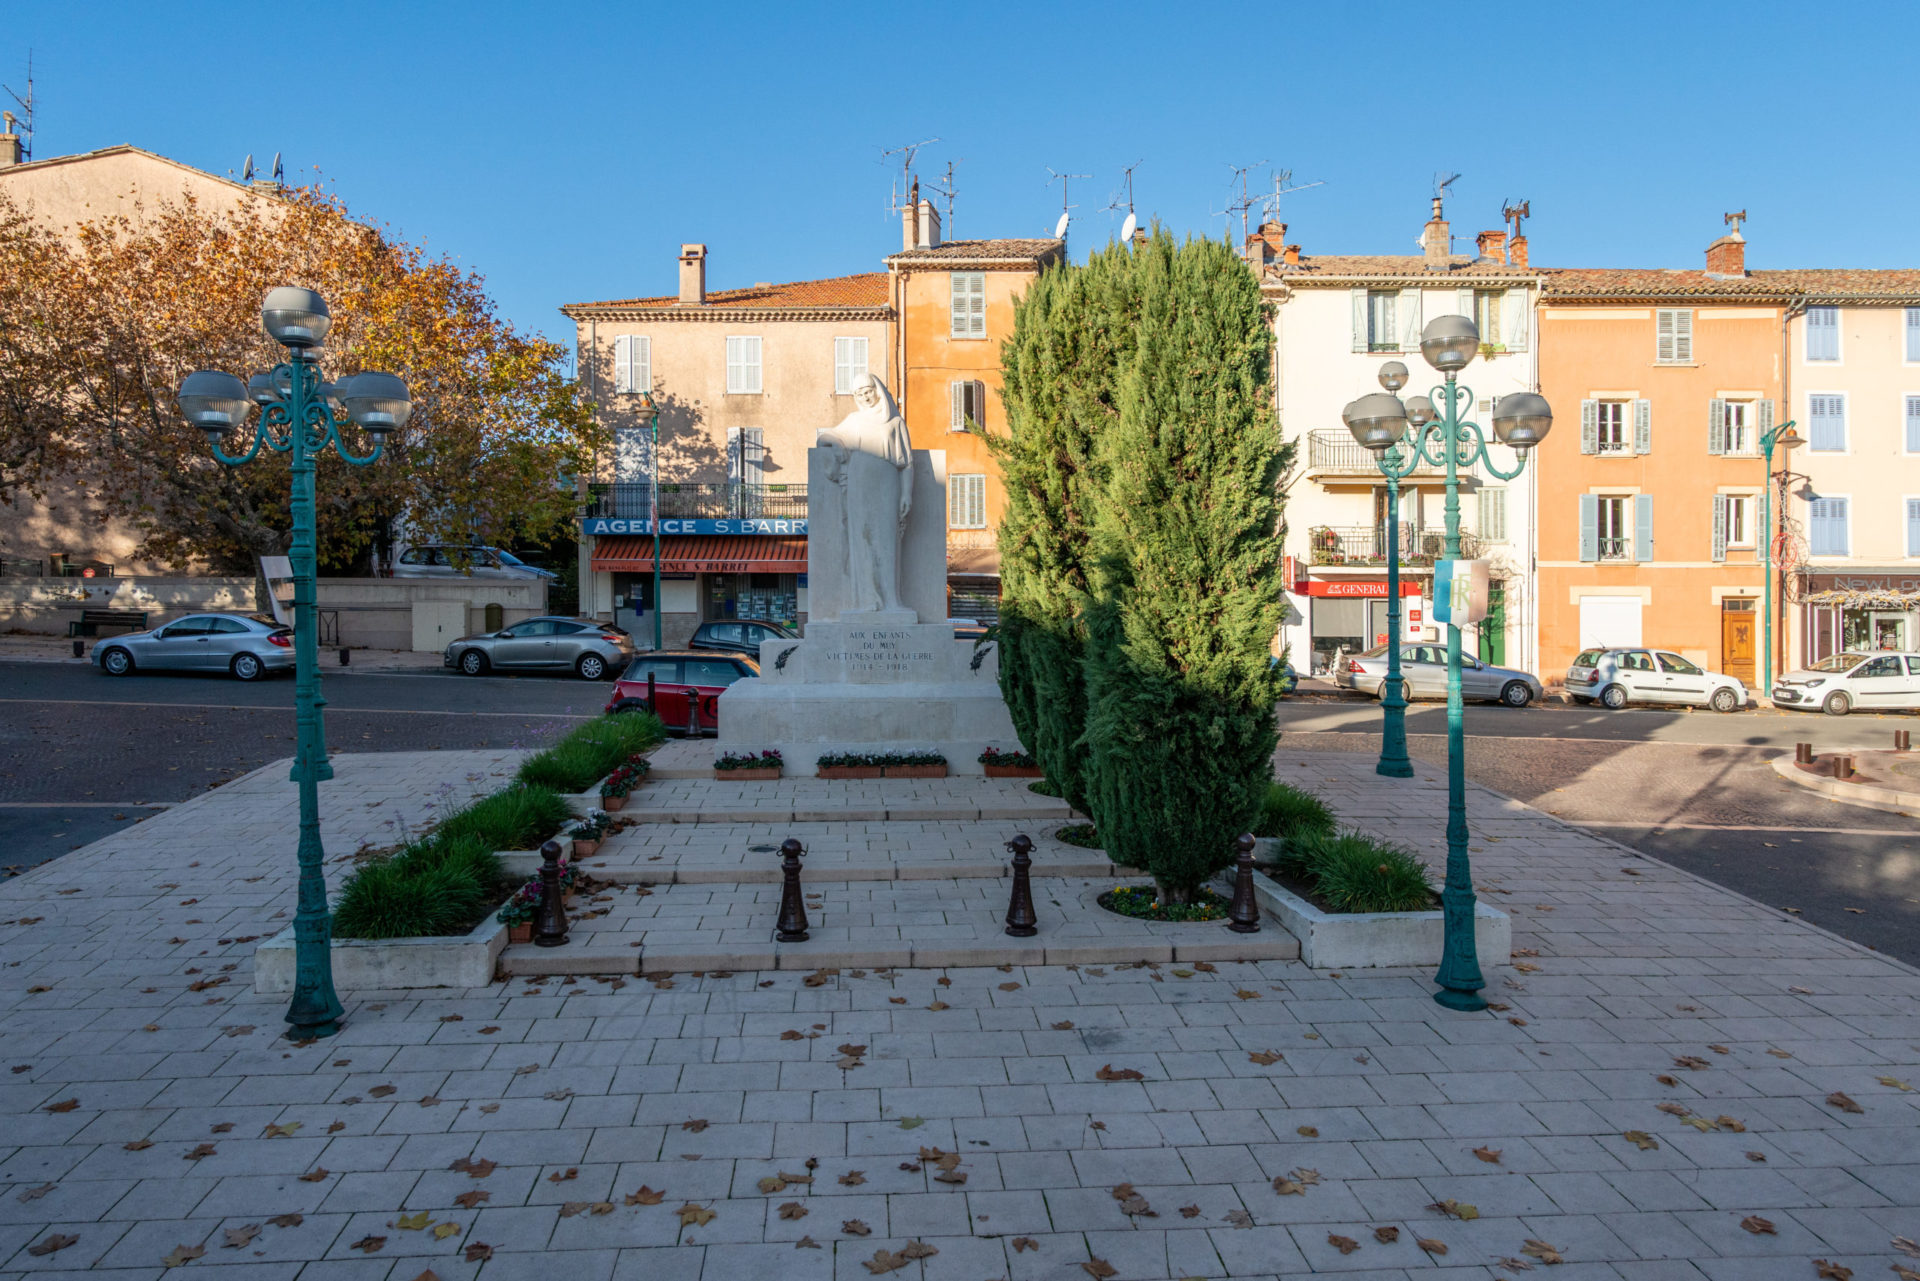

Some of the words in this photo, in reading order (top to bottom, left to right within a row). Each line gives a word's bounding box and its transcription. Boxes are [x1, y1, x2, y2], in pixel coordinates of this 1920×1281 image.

[594, 520, 696, 533] AGENCE
[706, 562, 748, 572] BARRET
[1834, 577, 1884, 590] New
[863, 642, 875, 650] DU
[880, 642, 896, 650] MUY
